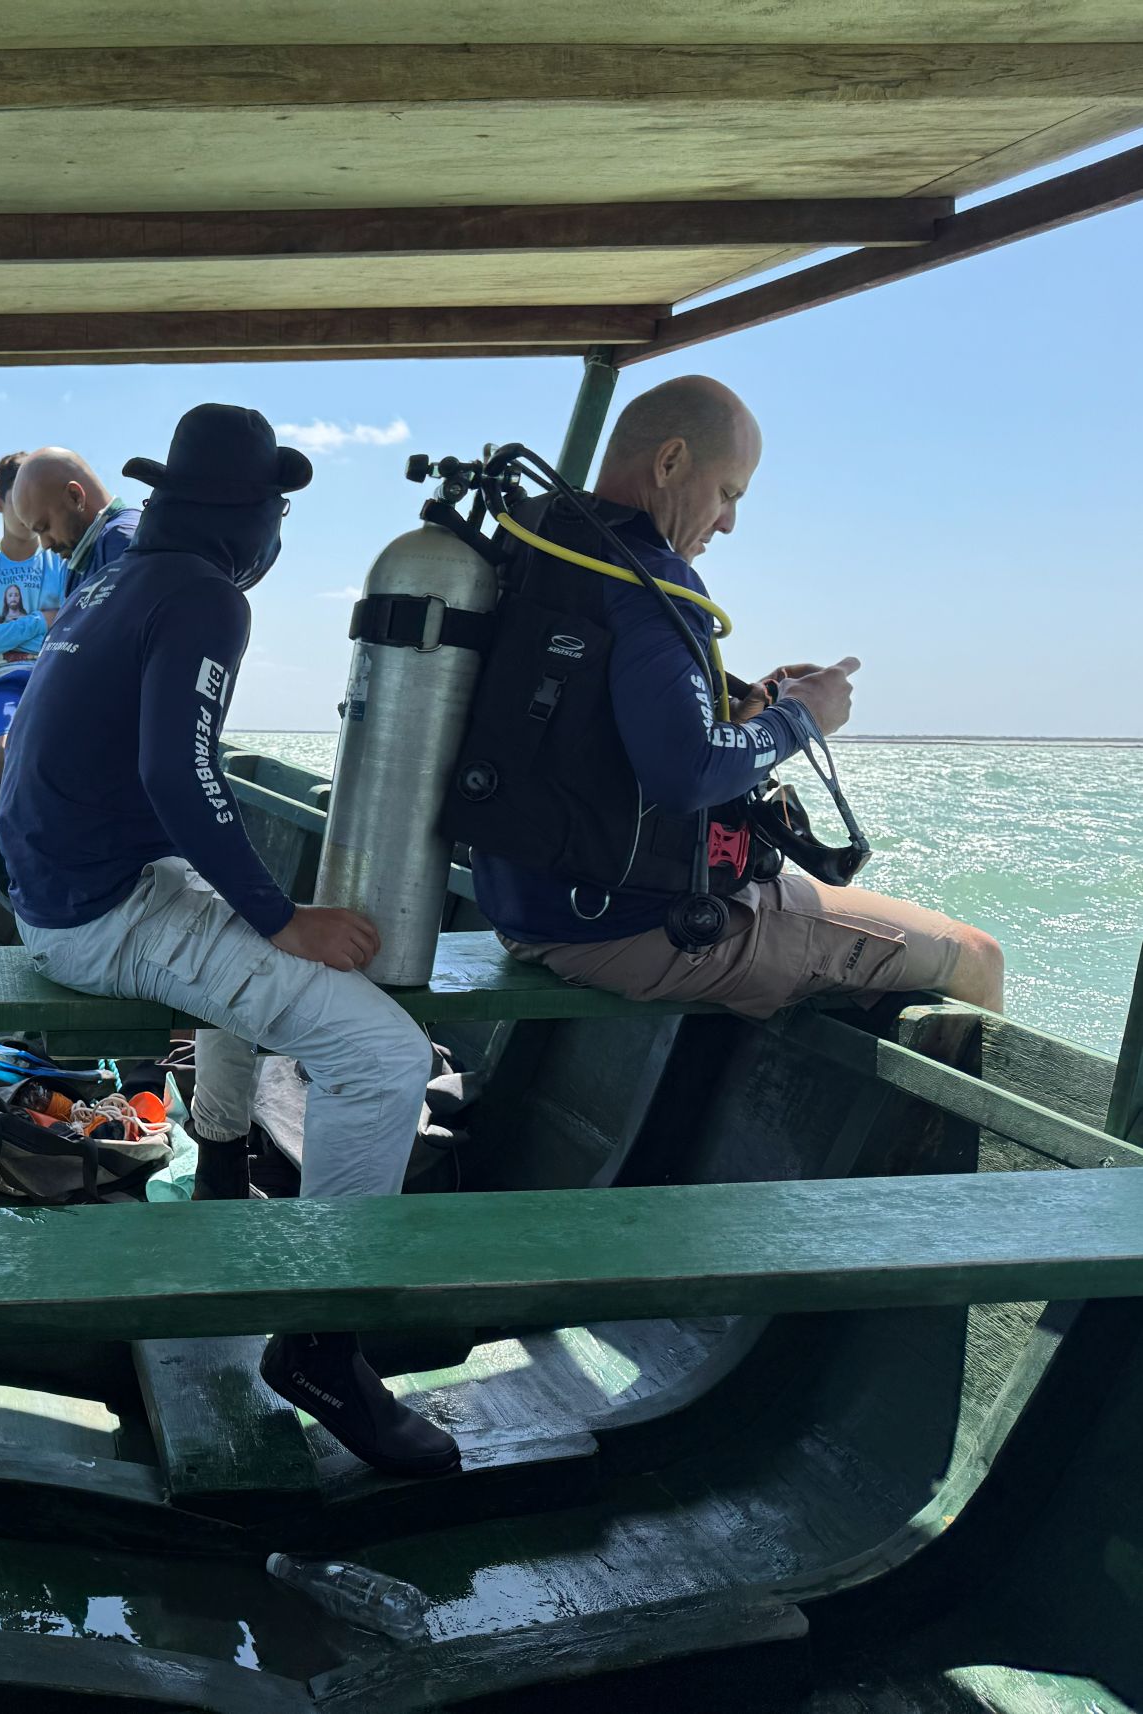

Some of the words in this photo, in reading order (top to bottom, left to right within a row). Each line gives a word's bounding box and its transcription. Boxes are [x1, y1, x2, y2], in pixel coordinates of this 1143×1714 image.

[194, 705, 234, 824] PETROBRAS
[846, 937, 867, 970] BRASIL
[322, 1393, 345, 1409] DIVE
